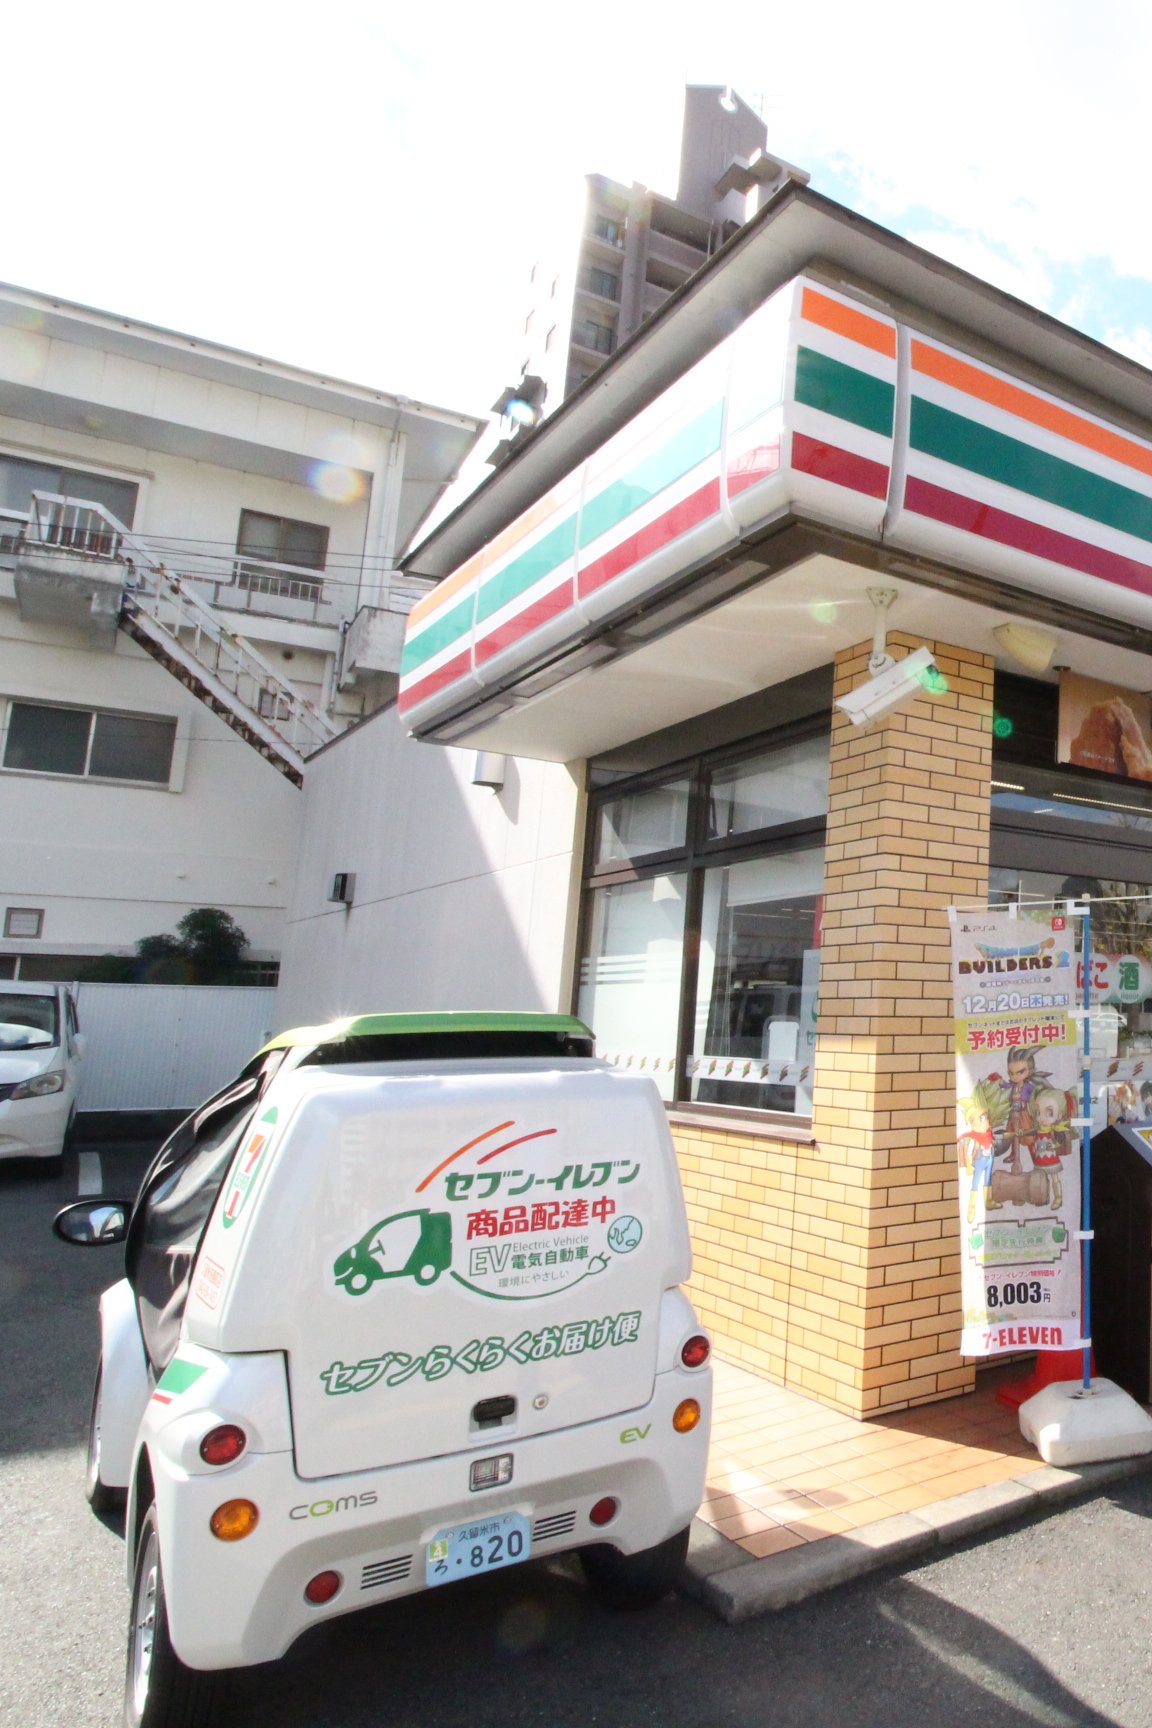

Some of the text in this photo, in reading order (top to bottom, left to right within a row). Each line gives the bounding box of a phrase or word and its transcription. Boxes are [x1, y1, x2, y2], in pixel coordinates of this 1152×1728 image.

[959, 955, 1052, 974] BUILDERS
[1119, 962, 1139, 990] 酒
[967, 1023, 1066, 1050] 予約受付中!
[466, 1195, 616, 1240] 商品配達中
[513, 1233, 589, 1253] Electric Vehicle
[469, 1243, 512, 1277] EV
[511, 1246, 589, 1270] 電気自動車
[498, 1269, 570, 1288] 環境にやさしい
[320, 1311, 642, 1395] セブンらくらくお届け便
[620, 1424, 652, 1444] EV
[458, 1522, 500, 1543] 久留米市
